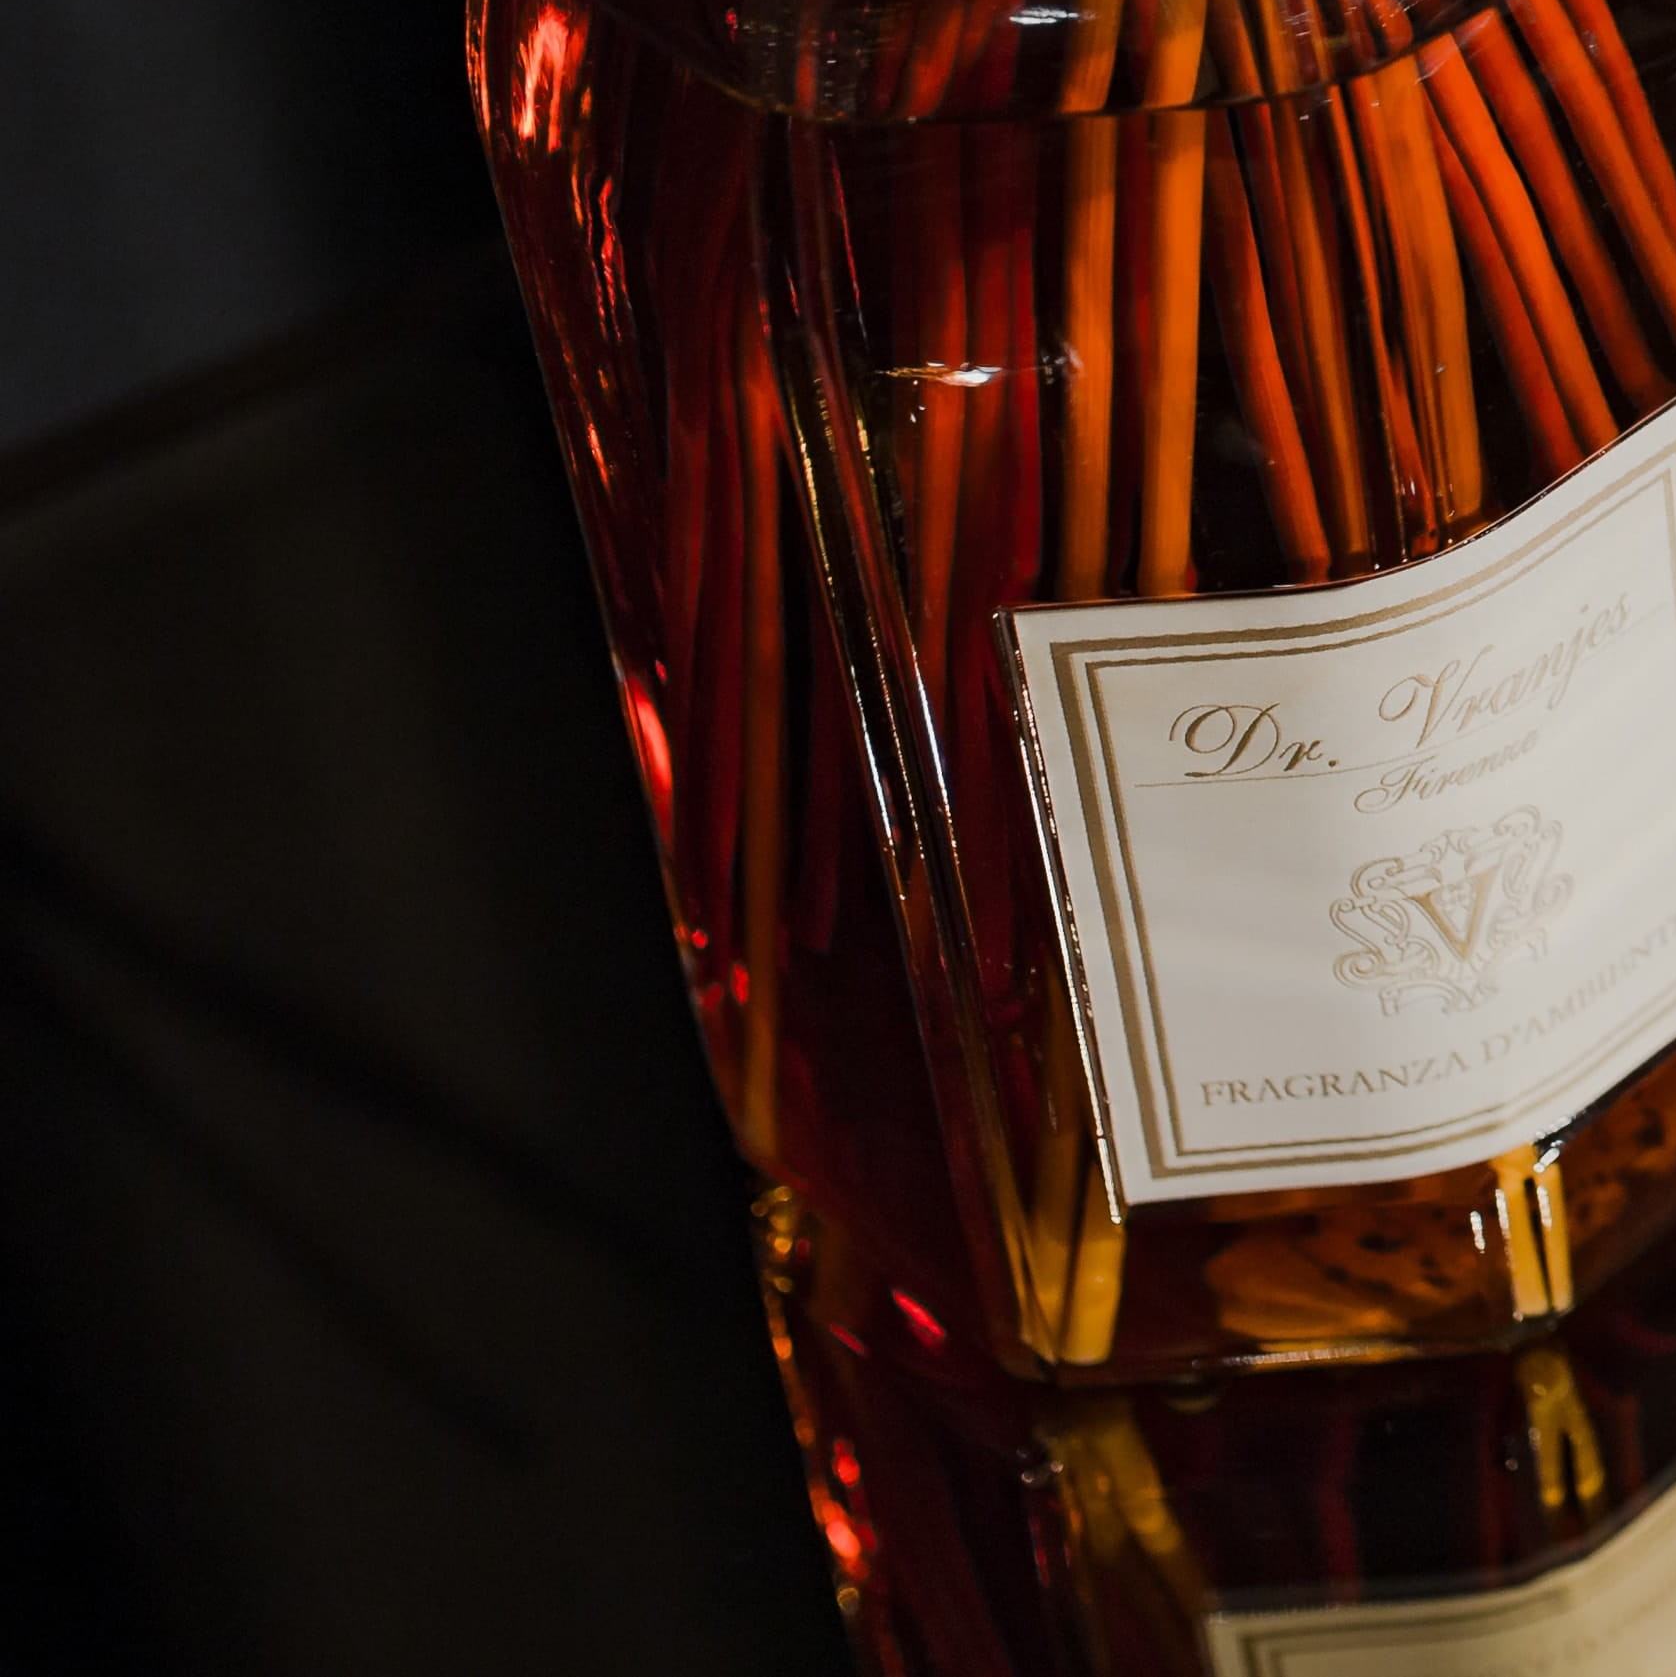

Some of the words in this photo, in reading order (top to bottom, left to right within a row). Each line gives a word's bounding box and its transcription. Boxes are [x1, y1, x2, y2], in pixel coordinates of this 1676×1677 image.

[1169, 703, 1340, 778] Dr.
[1378, 592, 1632, 749] Vranjes
[1409, 865, 1499, 961] V
[1200, 1050, 1470, 1108] FRAGRANZA
